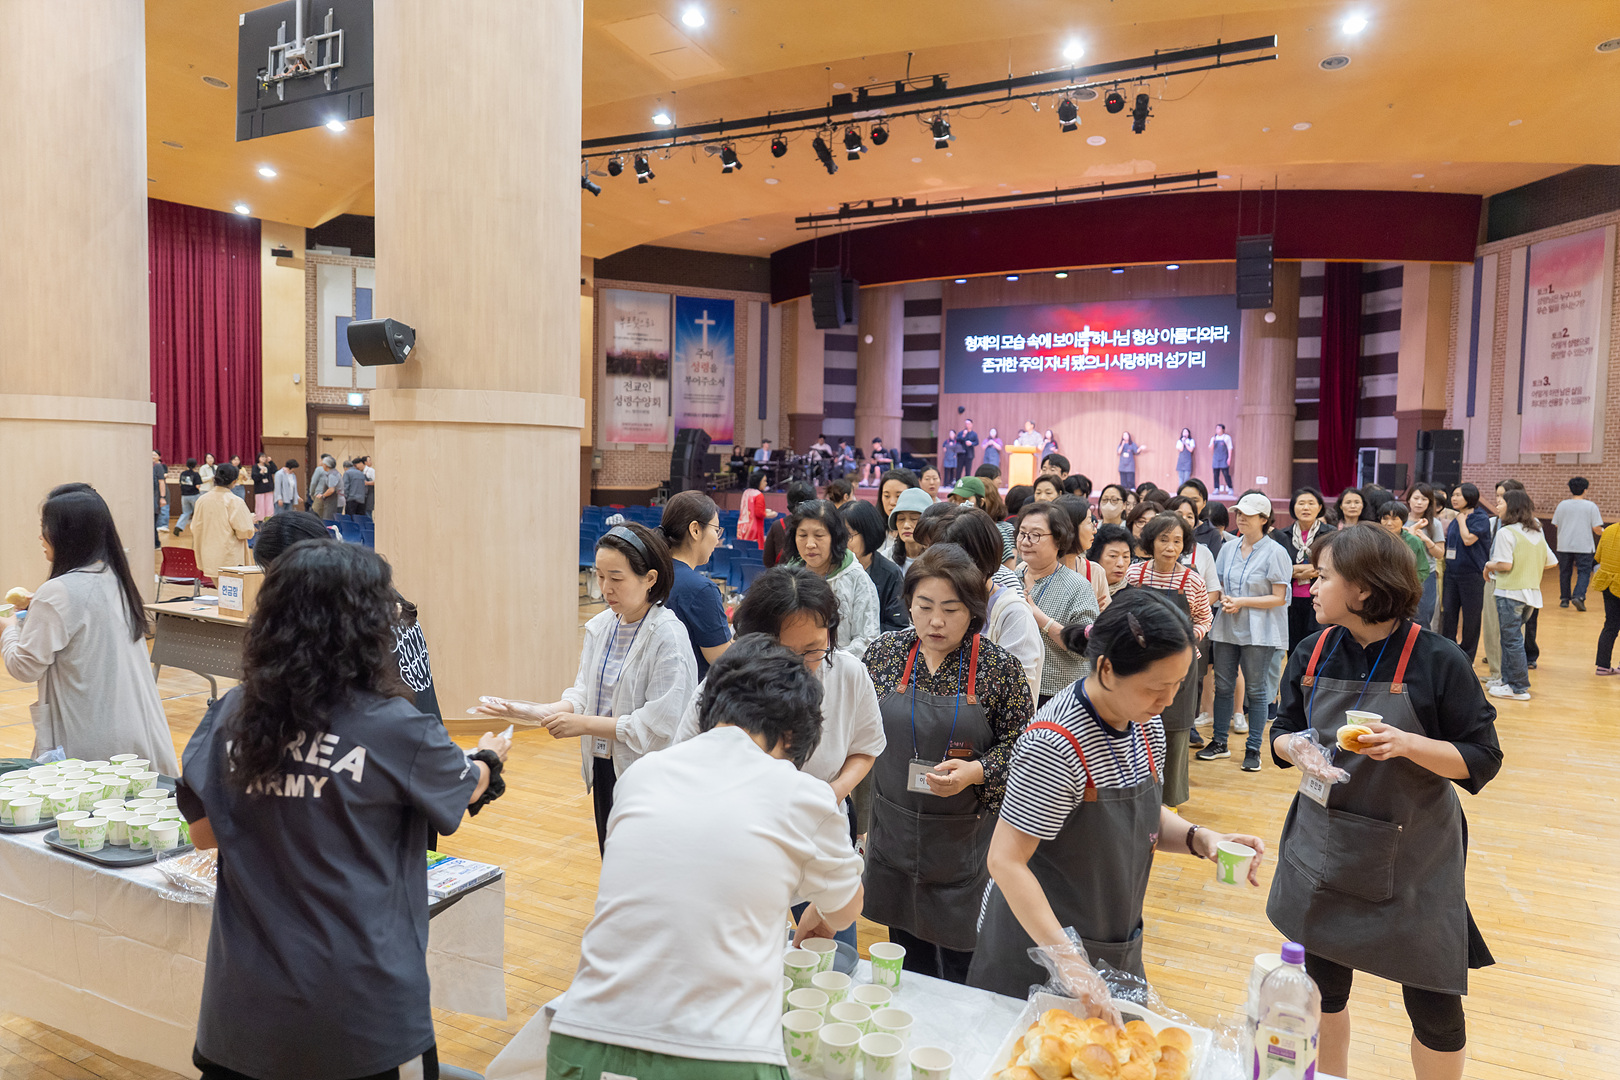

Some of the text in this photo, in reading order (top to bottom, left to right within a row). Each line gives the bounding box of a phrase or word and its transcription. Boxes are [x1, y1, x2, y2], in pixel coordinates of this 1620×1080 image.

[965, 335, 1000, 352] 형제의
[1000, 334, 1026, 350] 모습
[1027, 333, 1051, 350] 속에
[1091, 330, 1130, 347] 하나님
[1132, 329, 1160, 346] 형상
[982, 350, 1206, 373] 존귀한 주의 자녀 됐으니 사랑하며 섬기리
[623, 380, 652, 393] 전교인
[684, 376, 725, 387] 부어주소서
[613, 395, 661, 408] 성령수양회
